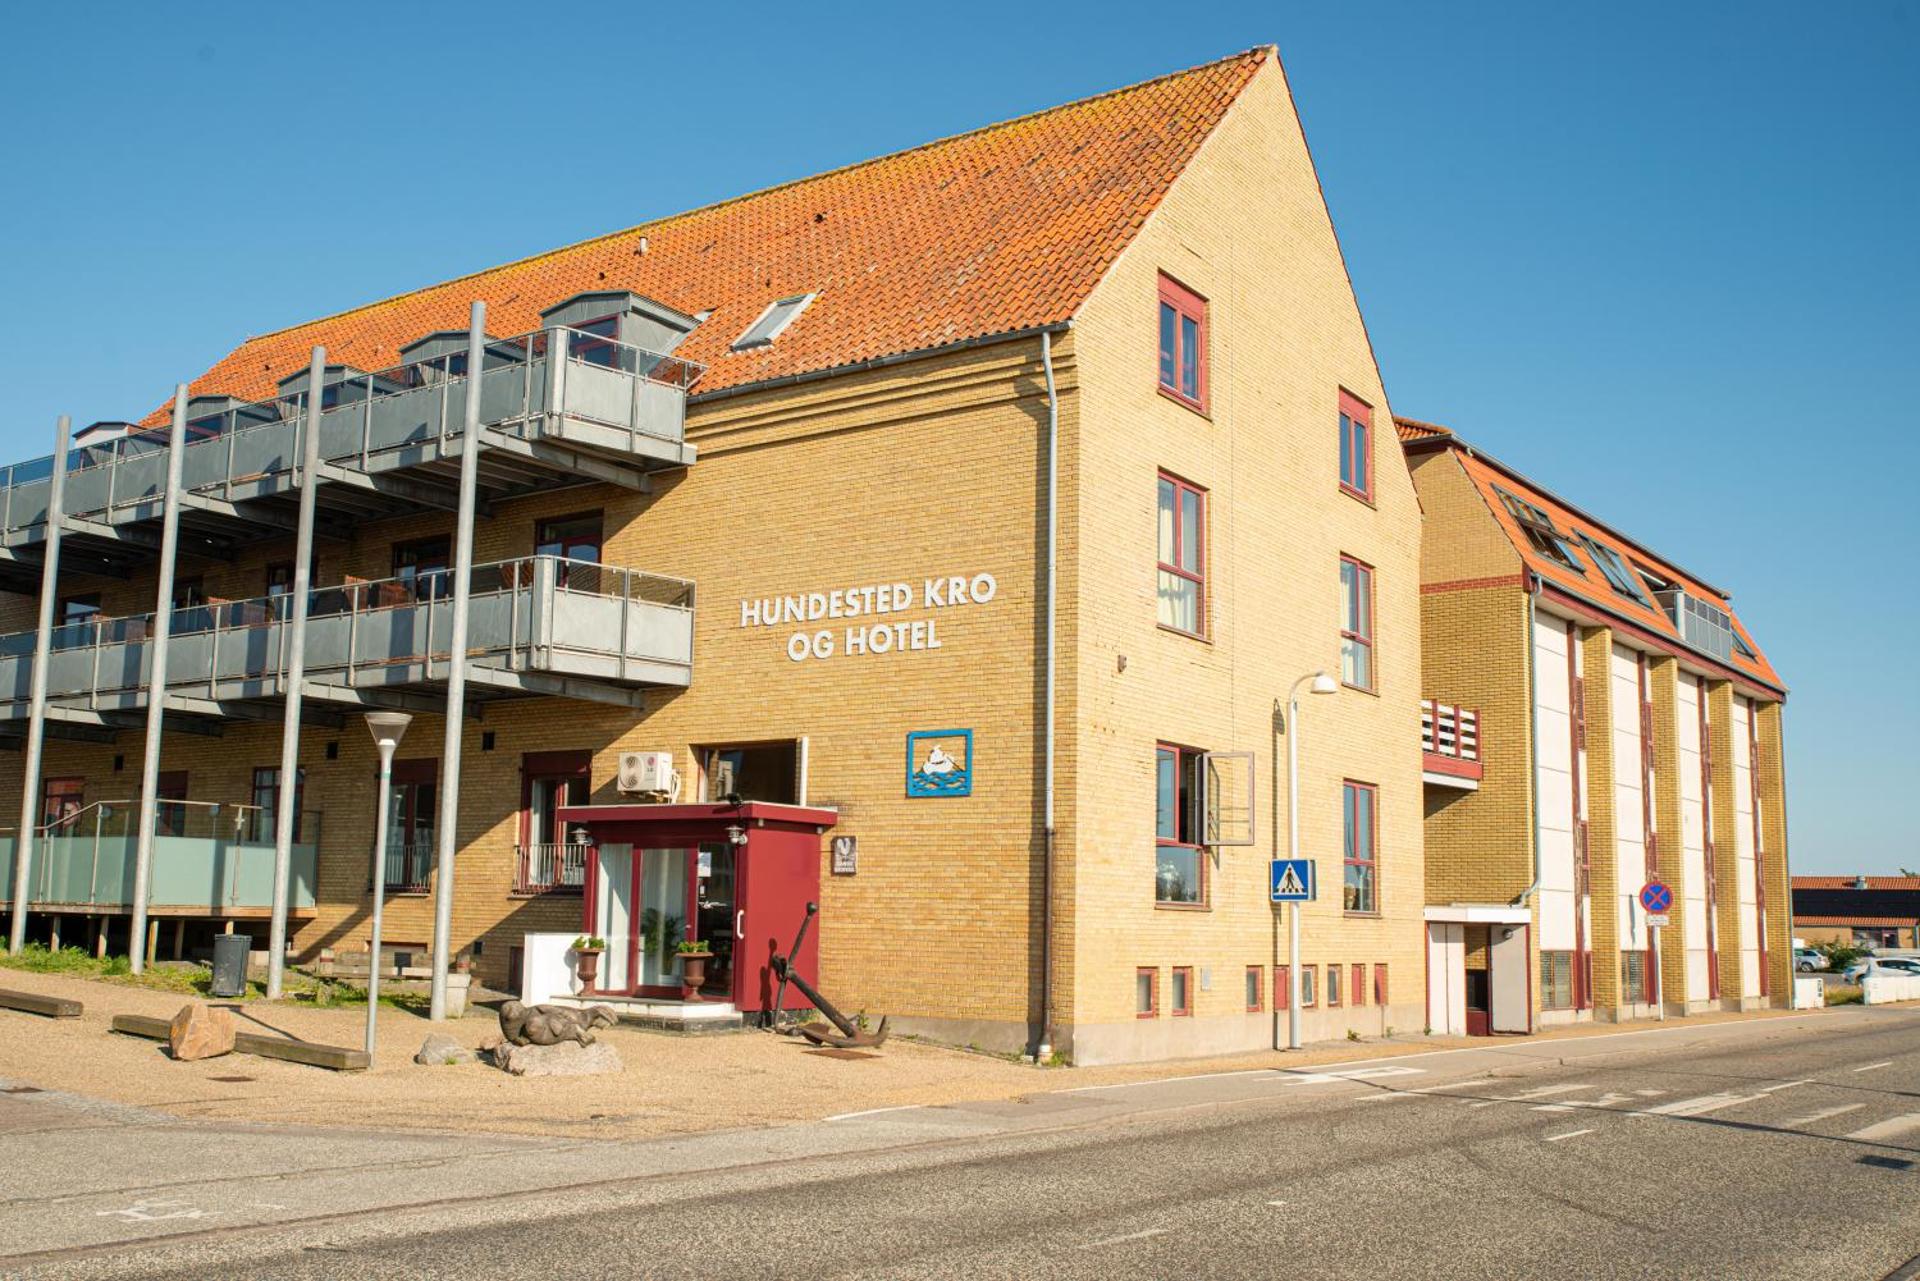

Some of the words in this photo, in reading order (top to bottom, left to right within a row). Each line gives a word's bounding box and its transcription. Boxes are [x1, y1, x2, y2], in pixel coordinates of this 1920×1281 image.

[740, 583, 914, 627] HUNDESTED
[924, 572, 997, 608] KRO
[787, 630, 834, 661] OG
[845, 620, 942, 655] HOTEL
